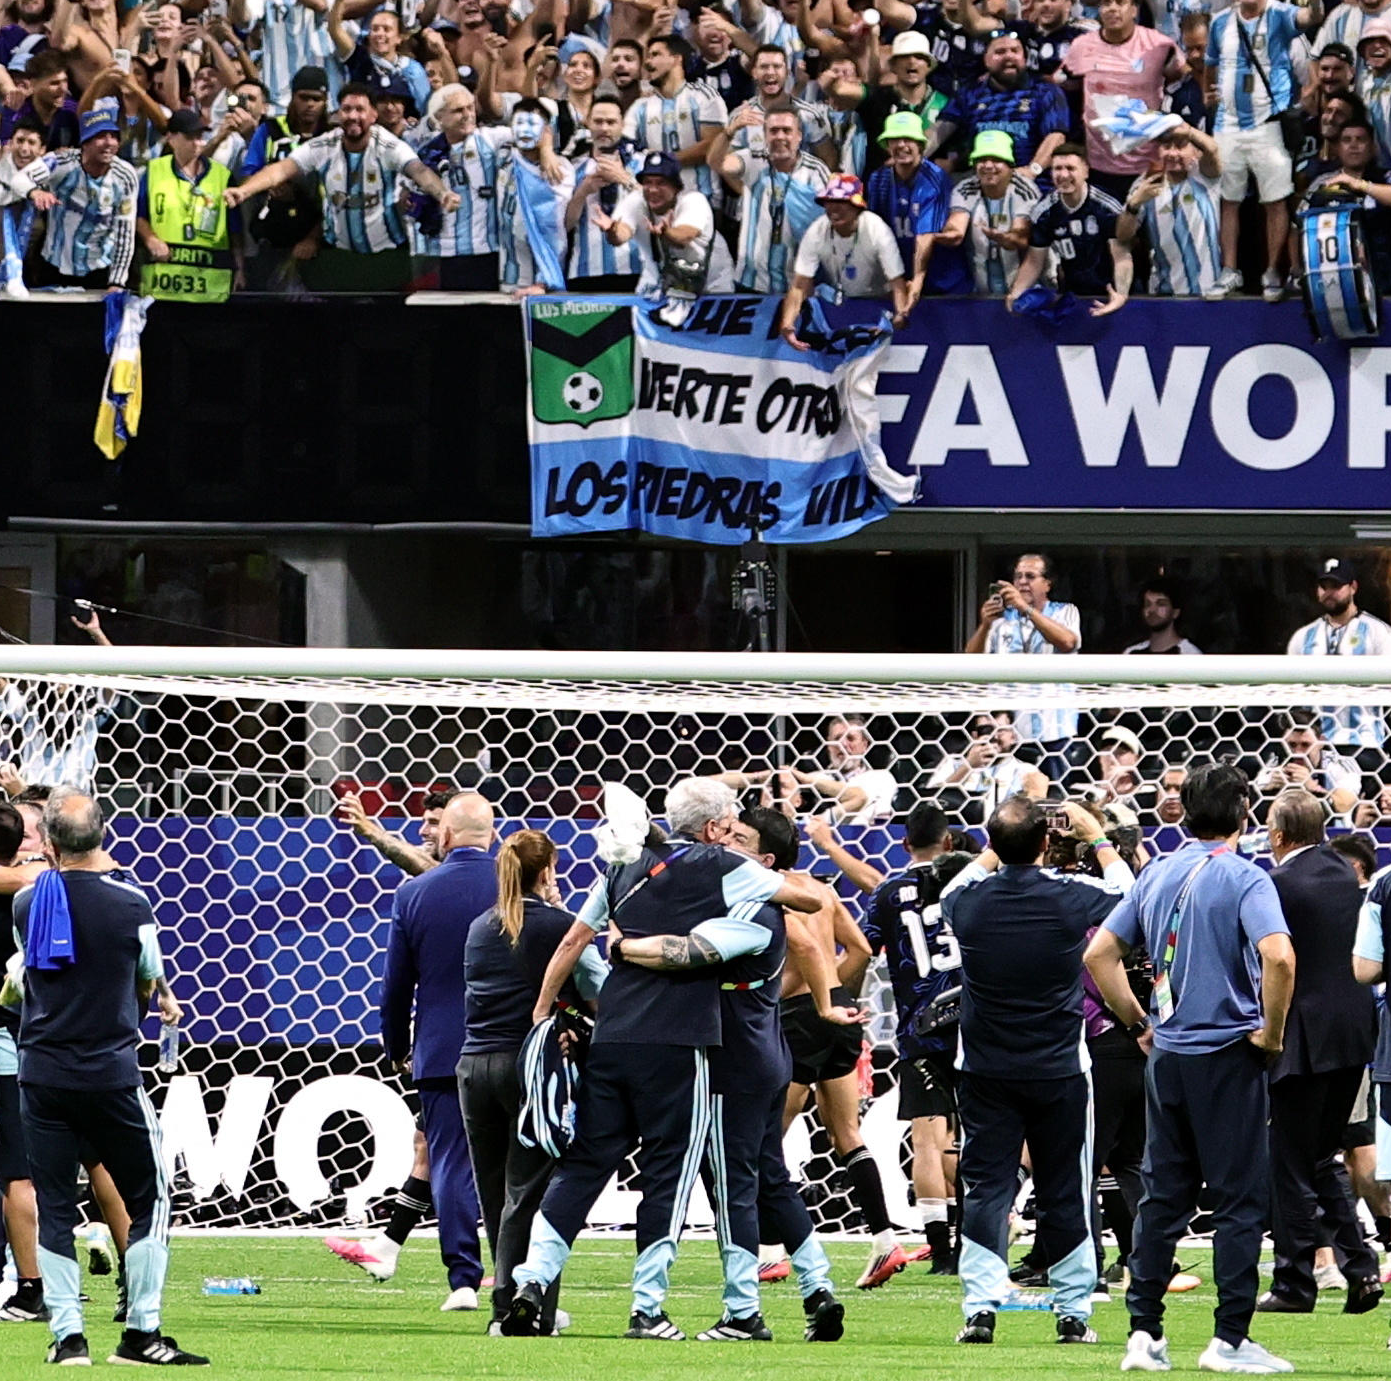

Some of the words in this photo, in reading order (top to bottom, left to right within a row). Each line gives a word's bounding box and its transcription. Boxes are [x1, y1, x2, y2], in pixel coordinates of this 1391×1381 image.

[932, 36, 949, 63] 10
[170, 247, 215, 265] URITY
[1051, 237, 1077, 261] 10
[1316, 235, 1340, 264] 10
[650, 297, 762, 334] UE
[638, 357, 753, 425] VERTE
[874, 344, 1030, 467] FA
[544, 460, 628, 518] LOS
[633, 461, 783, 531] PIEDRAS
[898, 885, 918, 903] RO
[900, 904, 962, 979] 13
